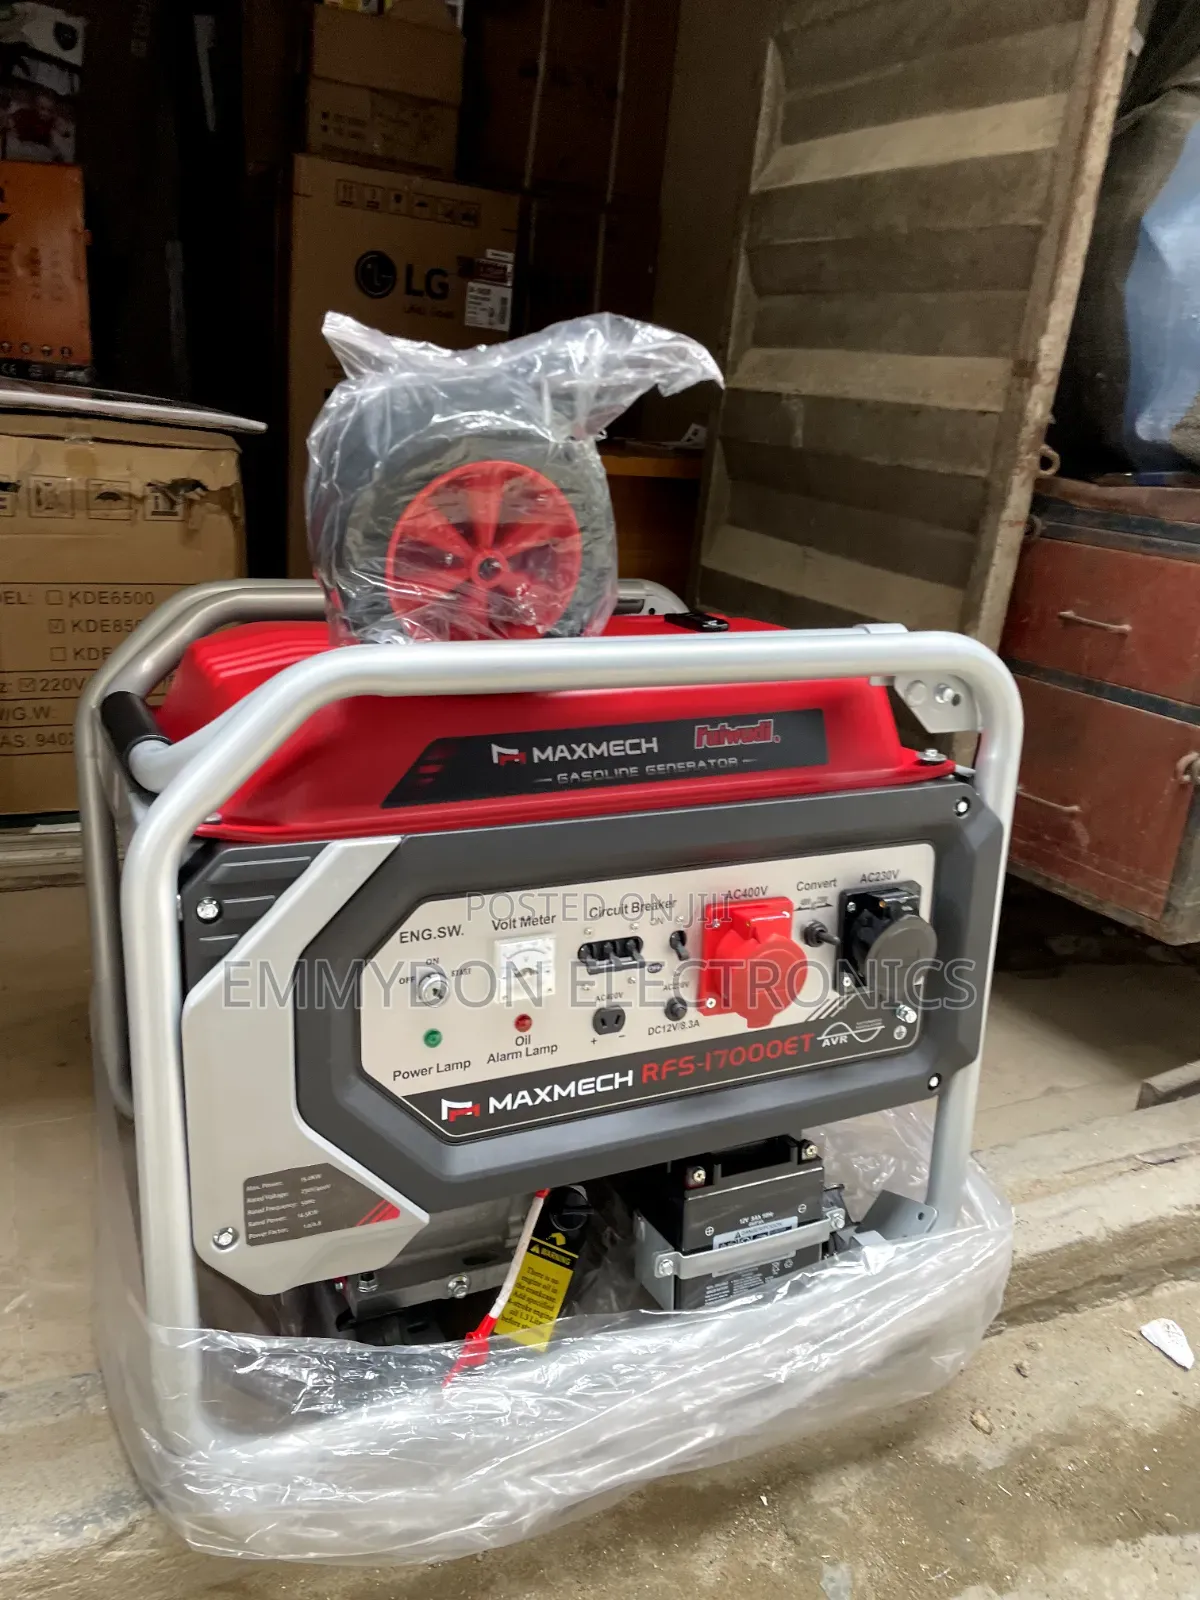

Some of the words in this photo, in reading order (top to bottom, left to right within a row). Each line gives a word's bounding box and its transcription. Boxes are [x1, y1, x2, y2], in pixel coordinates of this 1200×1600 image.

[405, 263, 450, 300] LG
[69, 591, 155, 606] KDE6500
[40, 678, 85, 692] 220V
[532, 737, 659, 763] MAXMECH
[557, 766, 640, 784] GASOLINE
[645, 757, 739, 776] GENERATOR
[860, 869, 900, 884] AC230V
[726, 886, 769, 900] AC400V
[796, 878, 838, 892] Convert
[589, 904, 629, 918] Circuit
[631, 898, 677, 914] Breaker
[491, 918, 517, 932] Volt
[520, 914, 556, 929] Meter
[400, 924, 464, 944] ENG.SW.
[425, 957, 440, 966] ON
[398, 976, 416, 985] OFF
[451, 968, 472, 977] START
[648, 1019, 700, 1036] DC12V/8.3A
[515, 1035, 531, 1046] Oil
[822, 1035, 848, 1048] AVR
[487, 1048, 522, 1064] Alarm
[525, 1043, 558, 1058] Lamp
[393, 1065, 434, 1081] Power
[436, 1059, 471, 1074] Lamp
[489, 1070, 634, 1114] MAXMECH
[641, 1033, 815, 1084] RFS-17000ET
